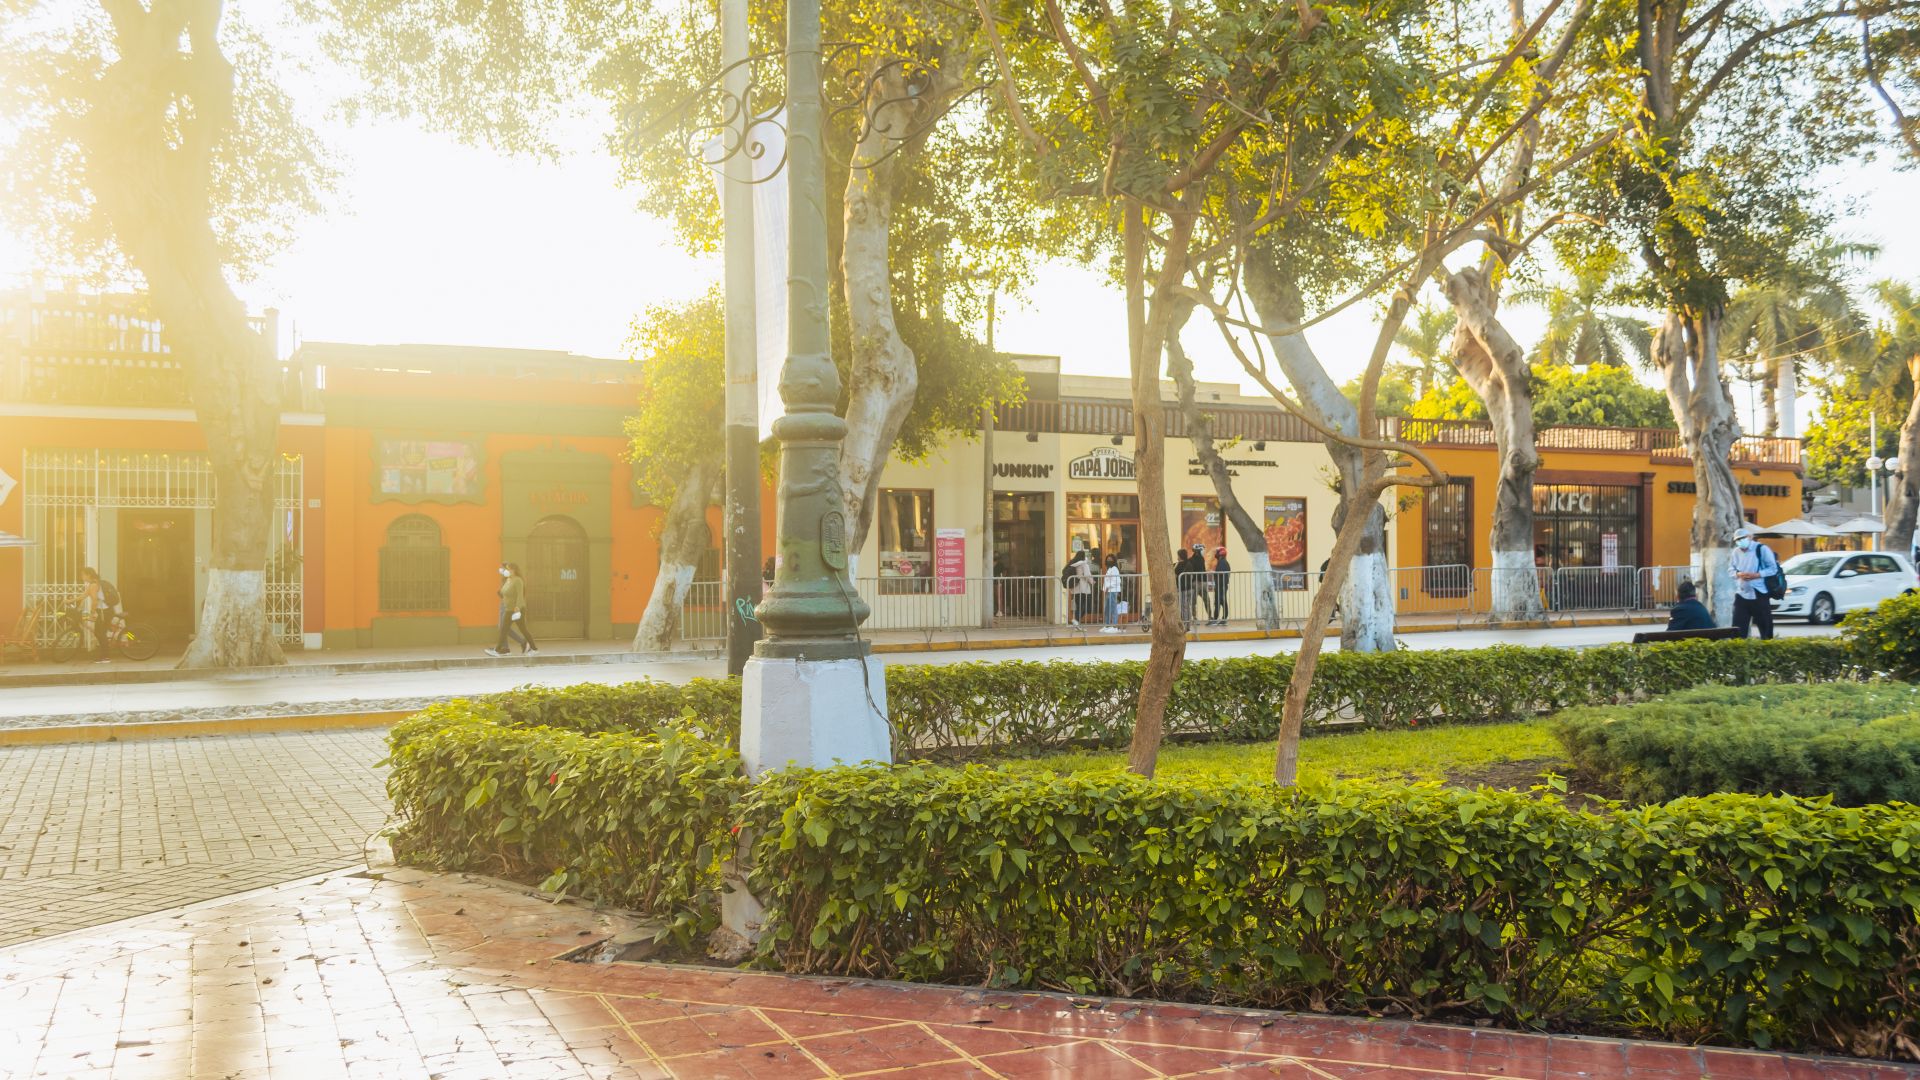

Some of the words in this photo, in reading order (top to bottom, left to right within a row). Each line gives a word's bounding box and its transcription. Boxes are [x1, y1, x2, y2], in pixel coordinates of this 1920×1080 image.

[1073, 457, 1101, 476] PAPA
[1104, 457, 1136, 477] JOHN
[1744, 484, 1791, 497] COFFEE
[1550, 493, 1592, 513] KFC
